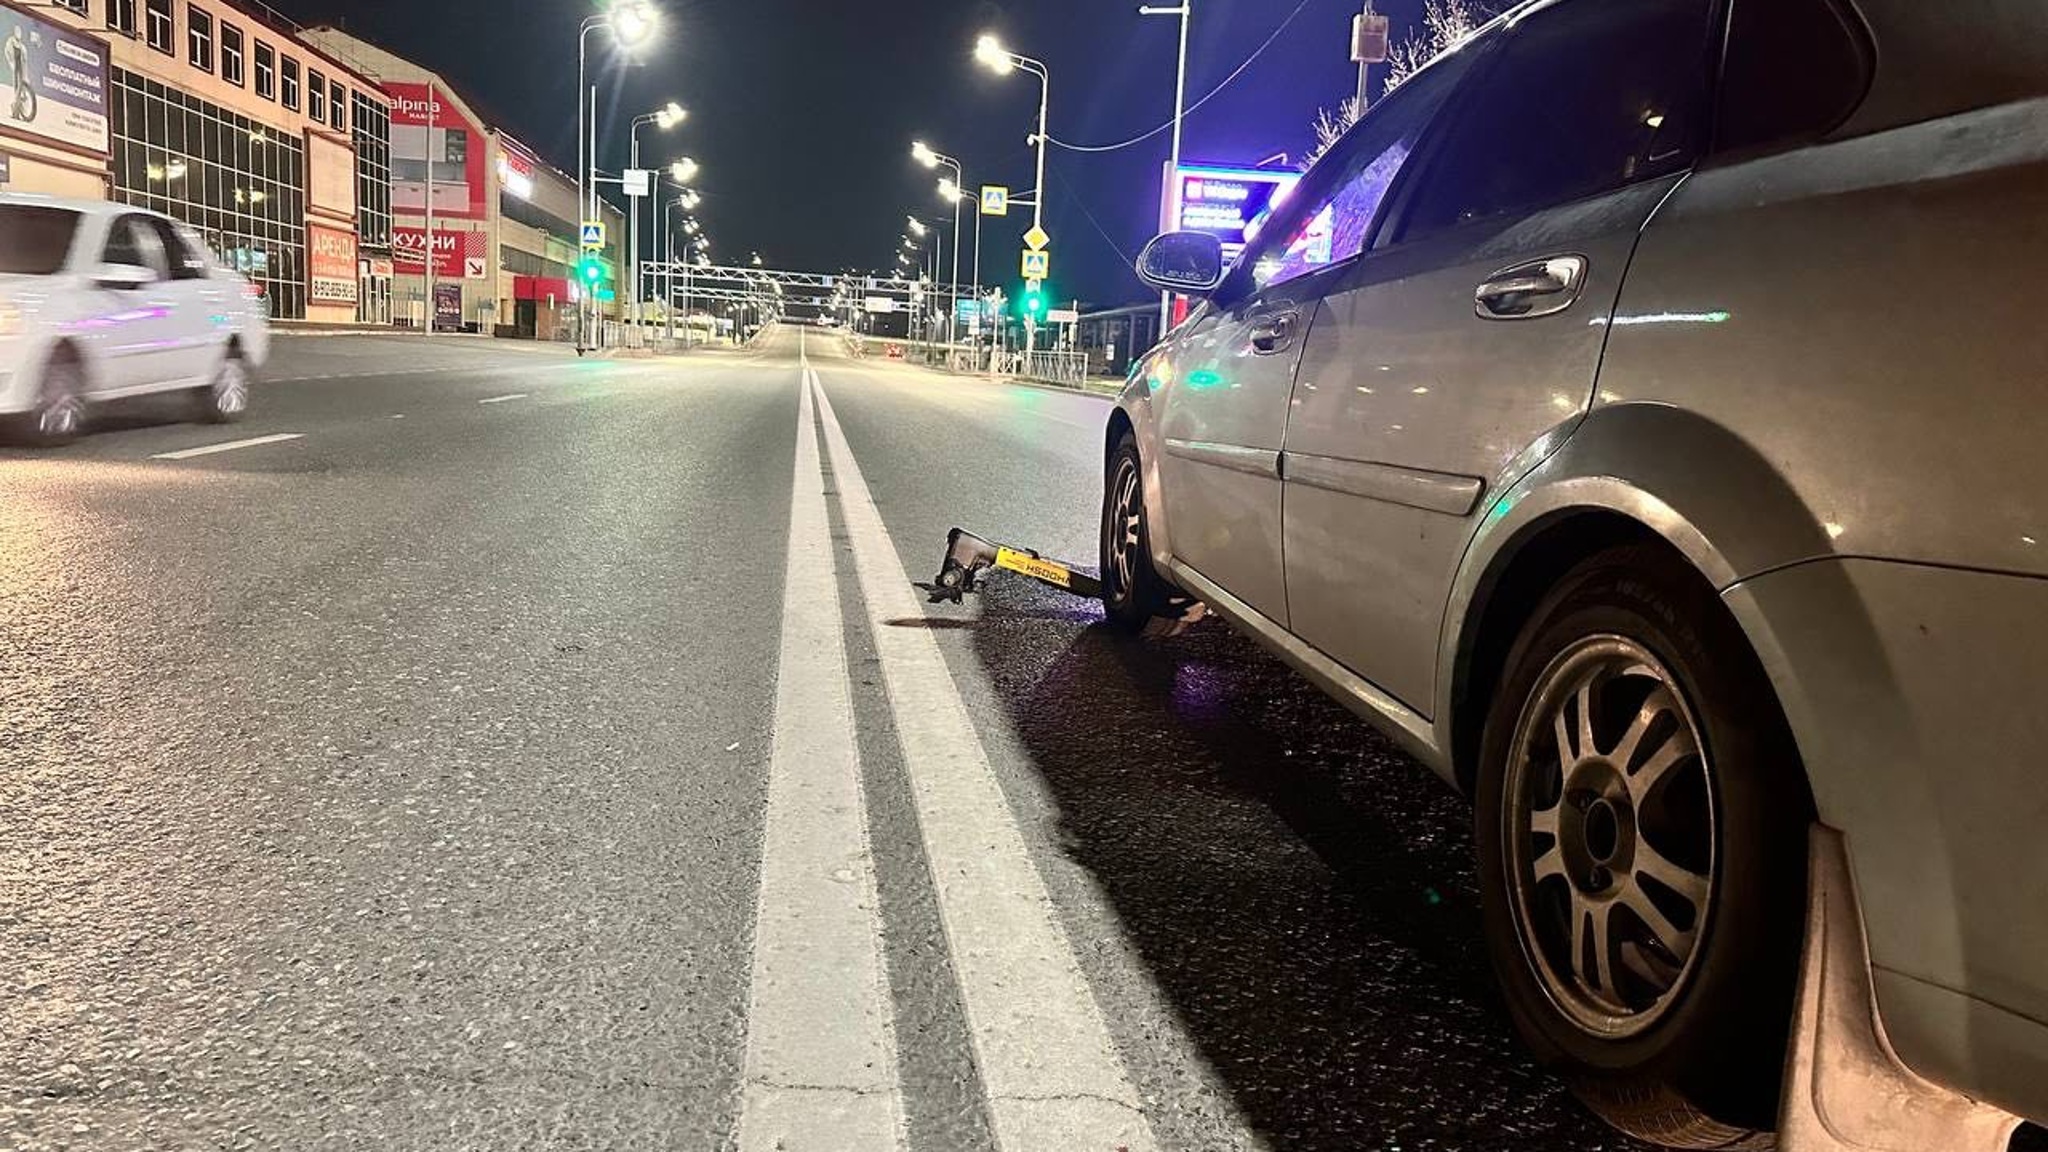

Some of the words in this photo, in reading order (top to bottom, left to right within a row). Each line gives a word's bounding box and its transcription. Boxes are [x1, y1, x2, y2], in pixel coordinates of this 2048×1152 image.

[389, 95, 441, 113] alpina
[313, 233, 355, 259] АРЕНДА
[393, 232, 456, 250] КУХНИ
